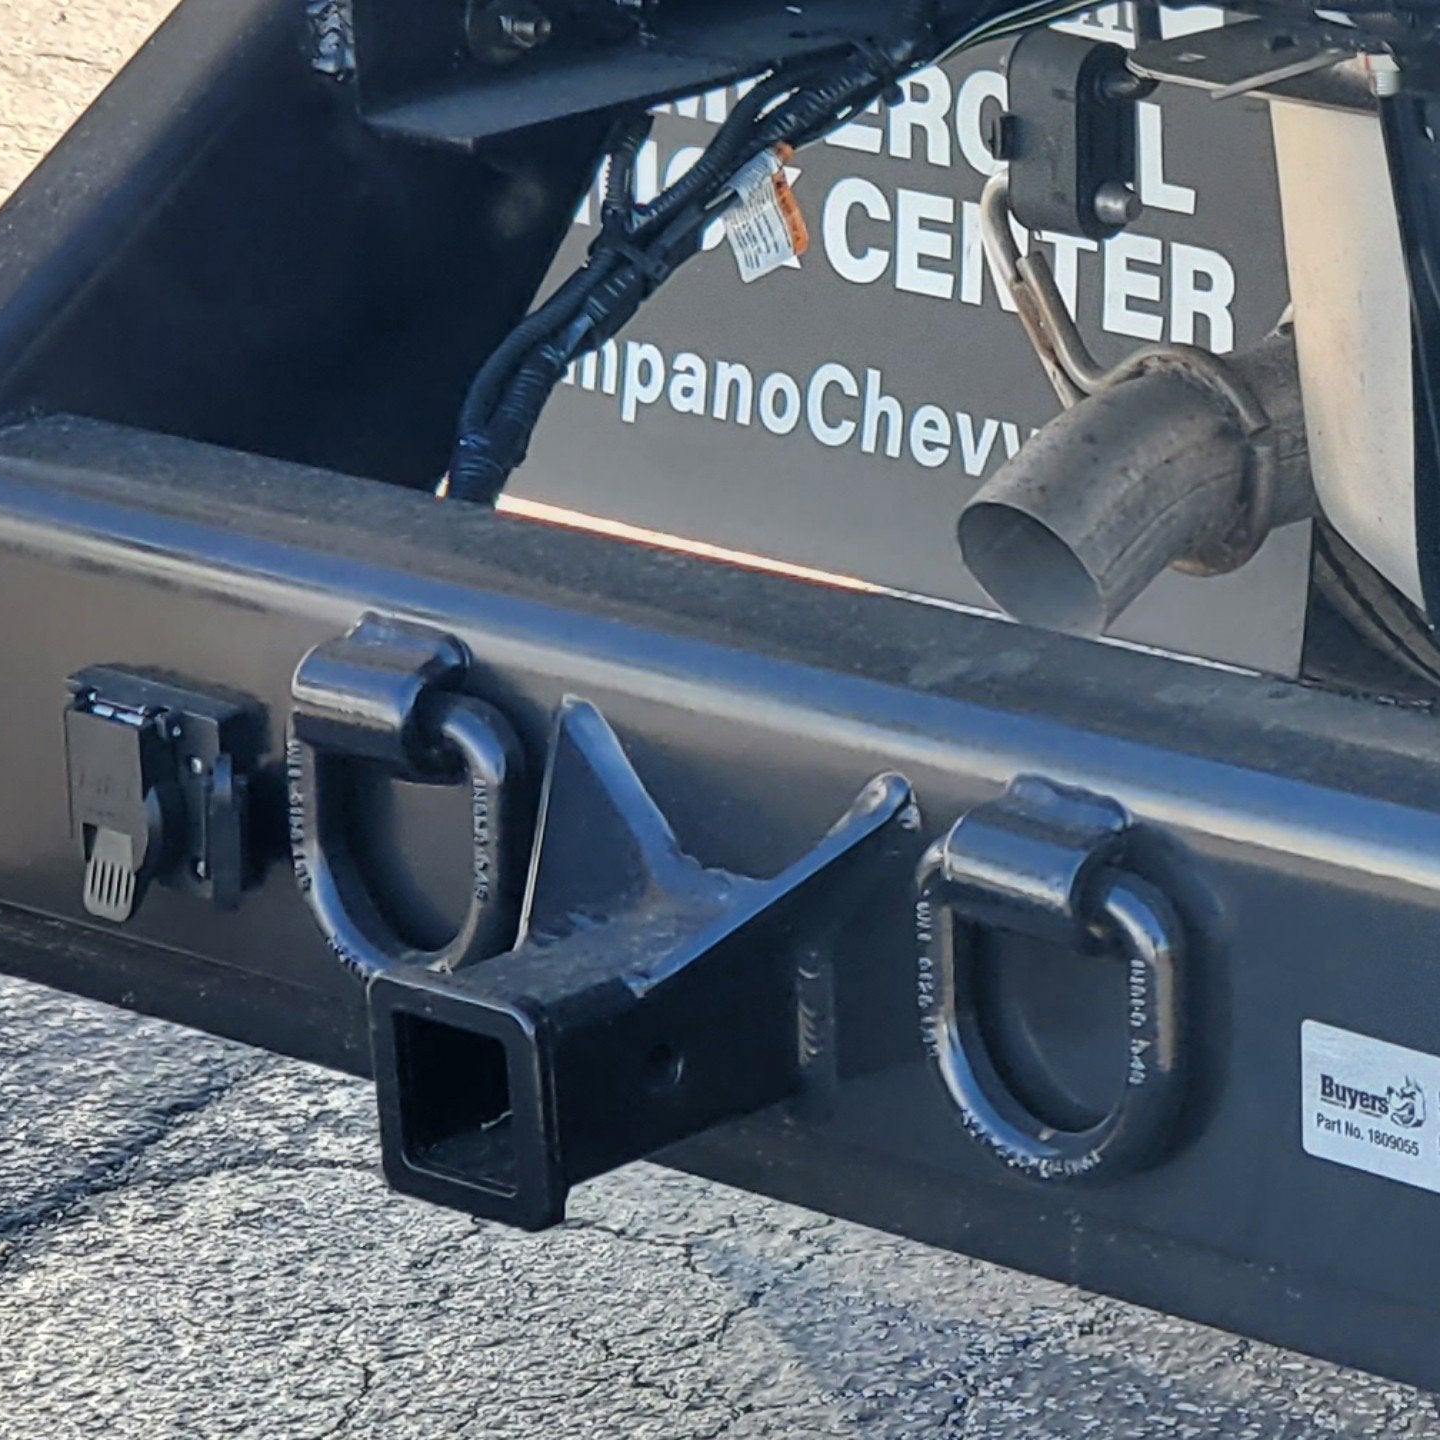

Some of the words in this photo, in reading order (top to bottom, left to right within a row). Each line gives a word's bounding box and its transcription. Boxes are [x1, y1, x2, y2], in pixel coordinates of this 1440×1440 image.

[1320, 1073, 1389, 1115] Buyers
[1316, 1112, 1341, 1134] Part
[1345, 1120, 1364, 1141] No.
[1368, 1128, 1420, 1157] 1809055
